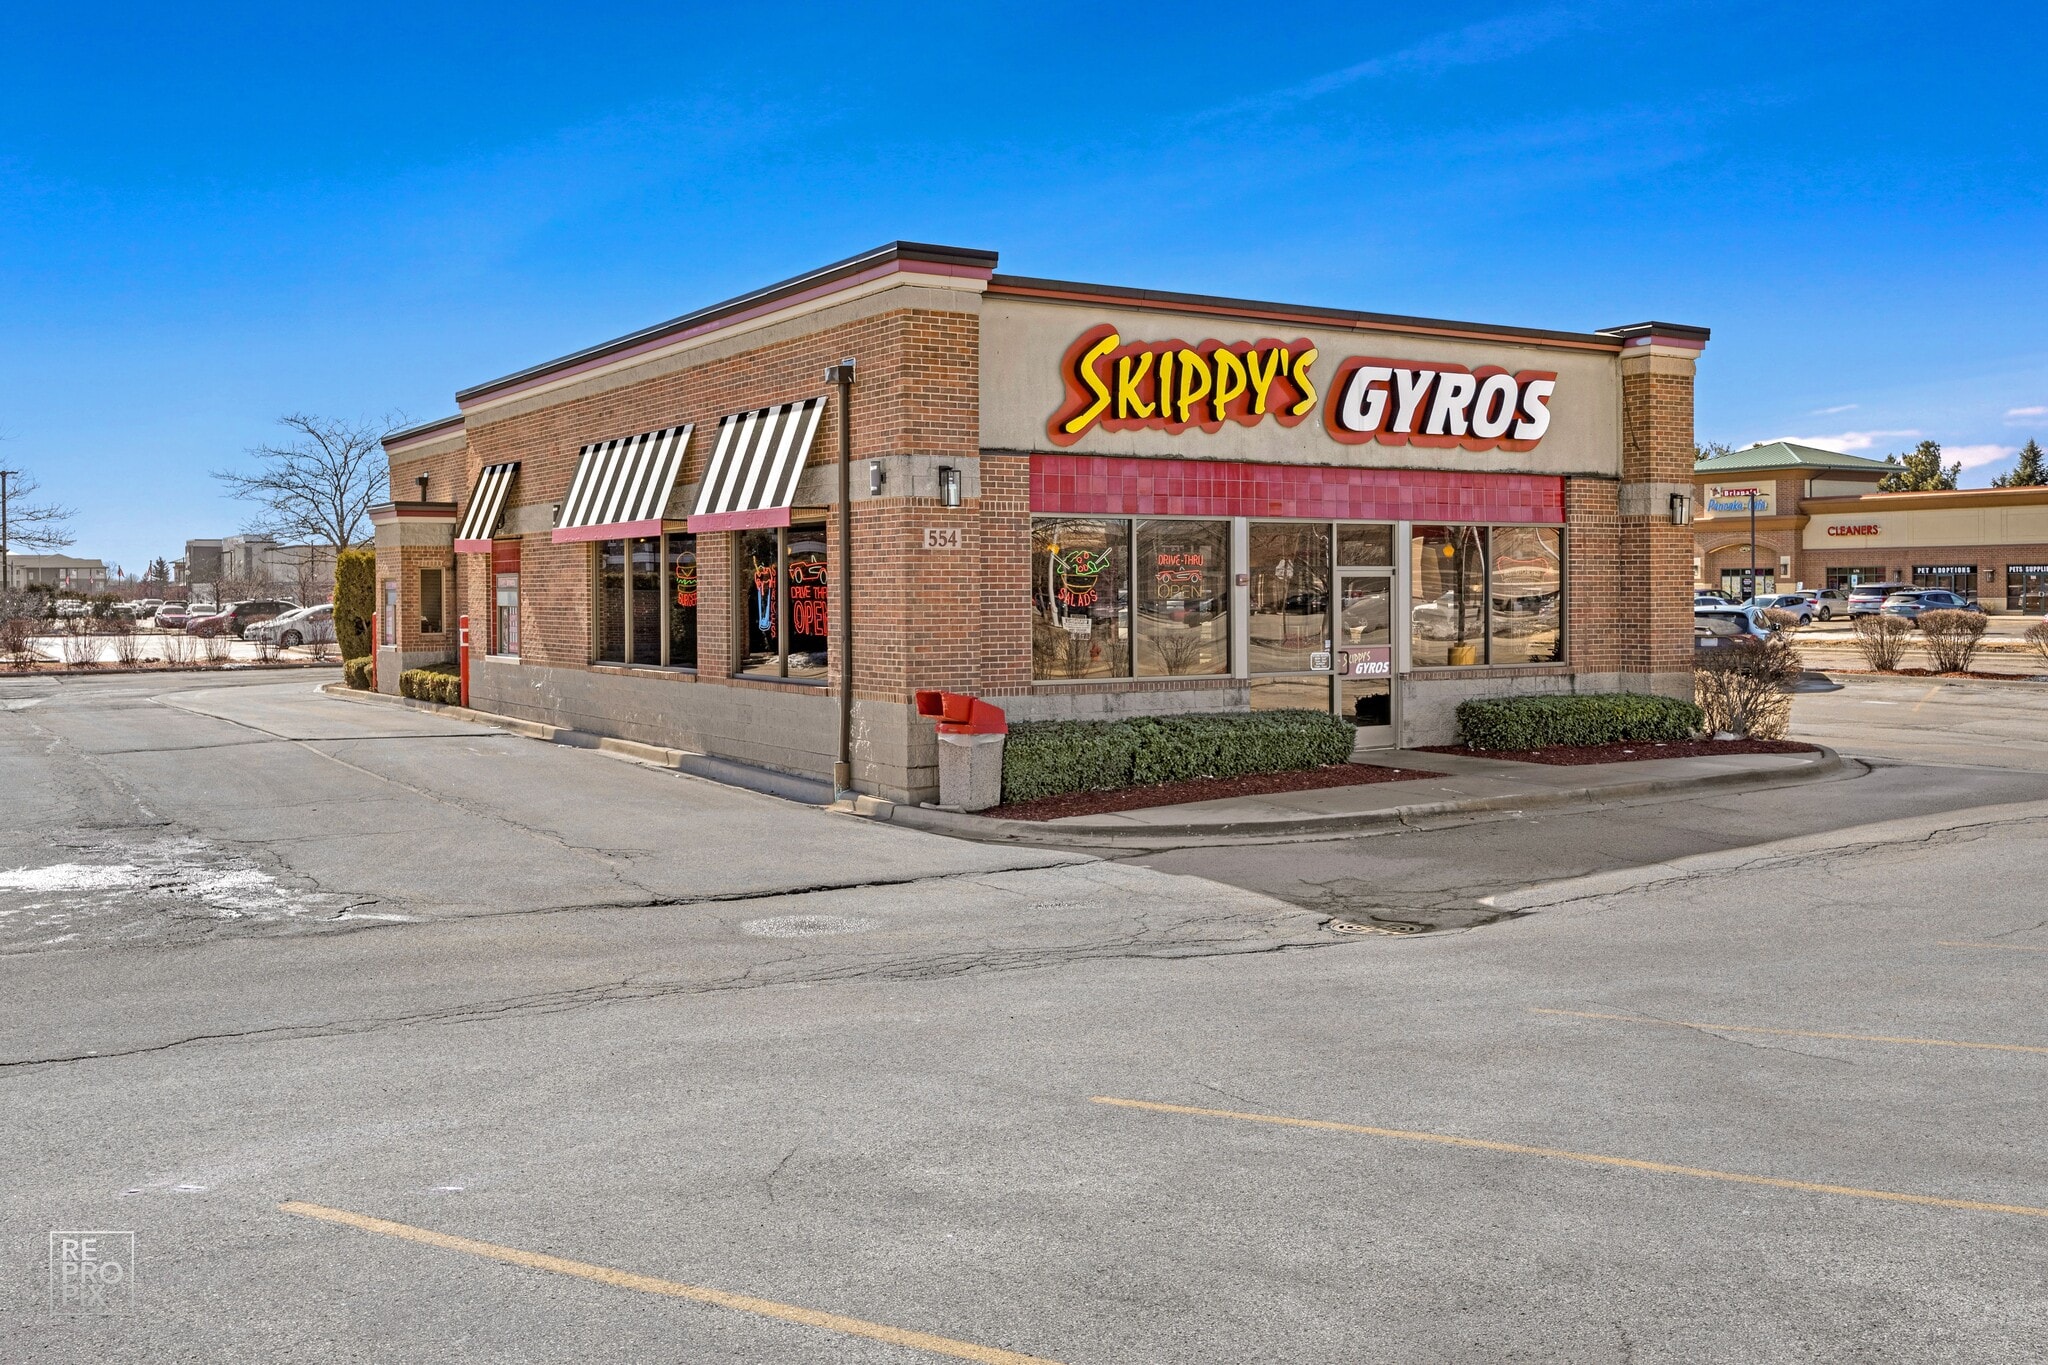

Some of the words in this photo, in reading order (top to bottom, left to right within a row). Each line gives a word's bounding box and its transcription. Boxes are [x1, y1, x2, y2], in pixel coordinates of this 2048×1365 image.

[1065, 333, 1319, 434] SKIPPY'S
[1342, 366, 1556, 440] GYROS
[1827, 524, 1879, 536] CLEANERS
[928, 530, 958, 547] 554
[1157, 554, 1204, 566] DRIVE-THRU
[1058, 587, 1098, 607] SALADS
[1157, 584, 1201, 599] OPEN
[1355, 661, 1390, 674] GYROS
